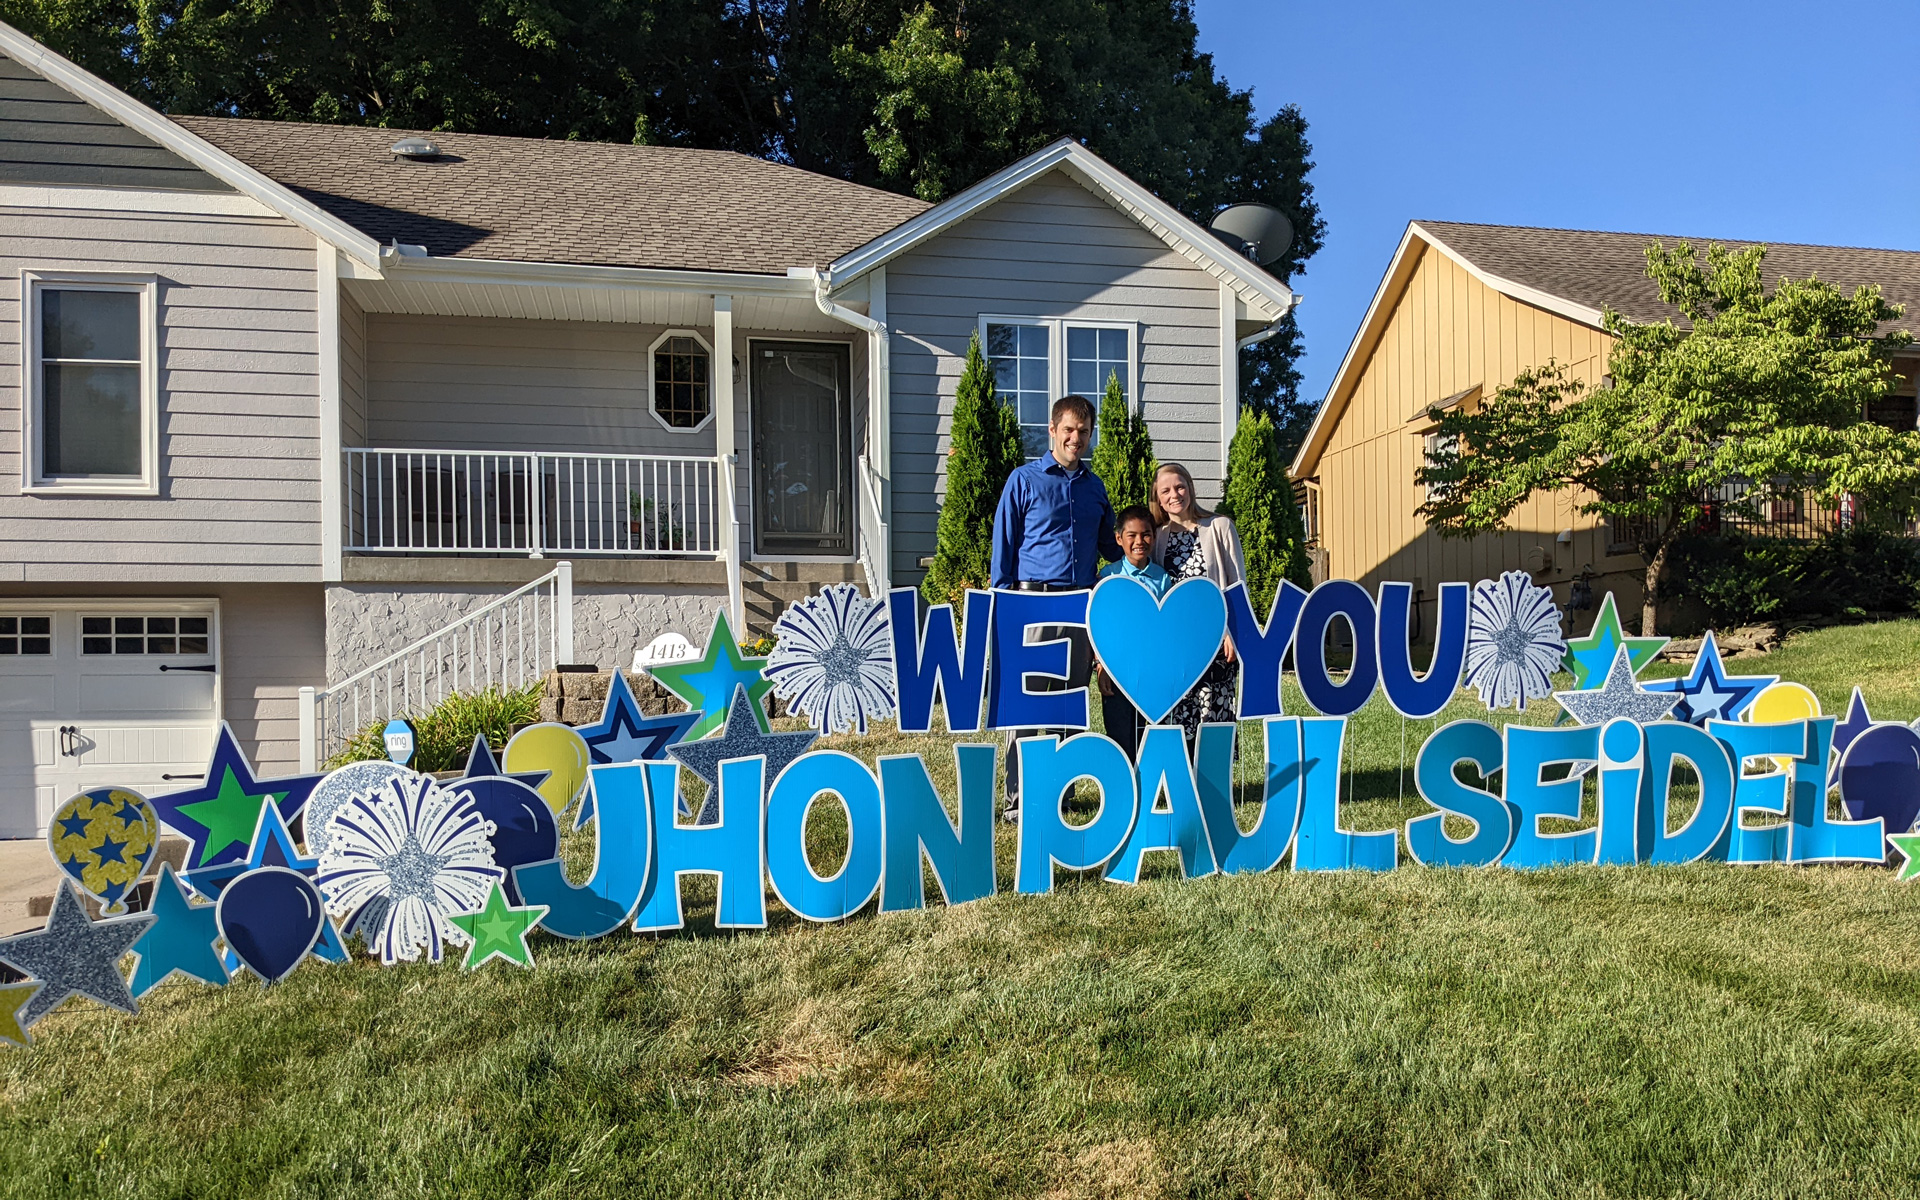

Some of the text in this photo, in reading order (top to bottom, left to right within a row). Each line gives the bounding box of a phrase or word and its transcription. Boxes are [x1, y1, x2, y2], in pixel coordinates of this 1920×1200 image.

[649, 643, 687, 660] 1413
[888, 578, 1470, 733] WE YOU
[390, 734, 407, 749] ring
[512, 743, 998, 940] JHON
